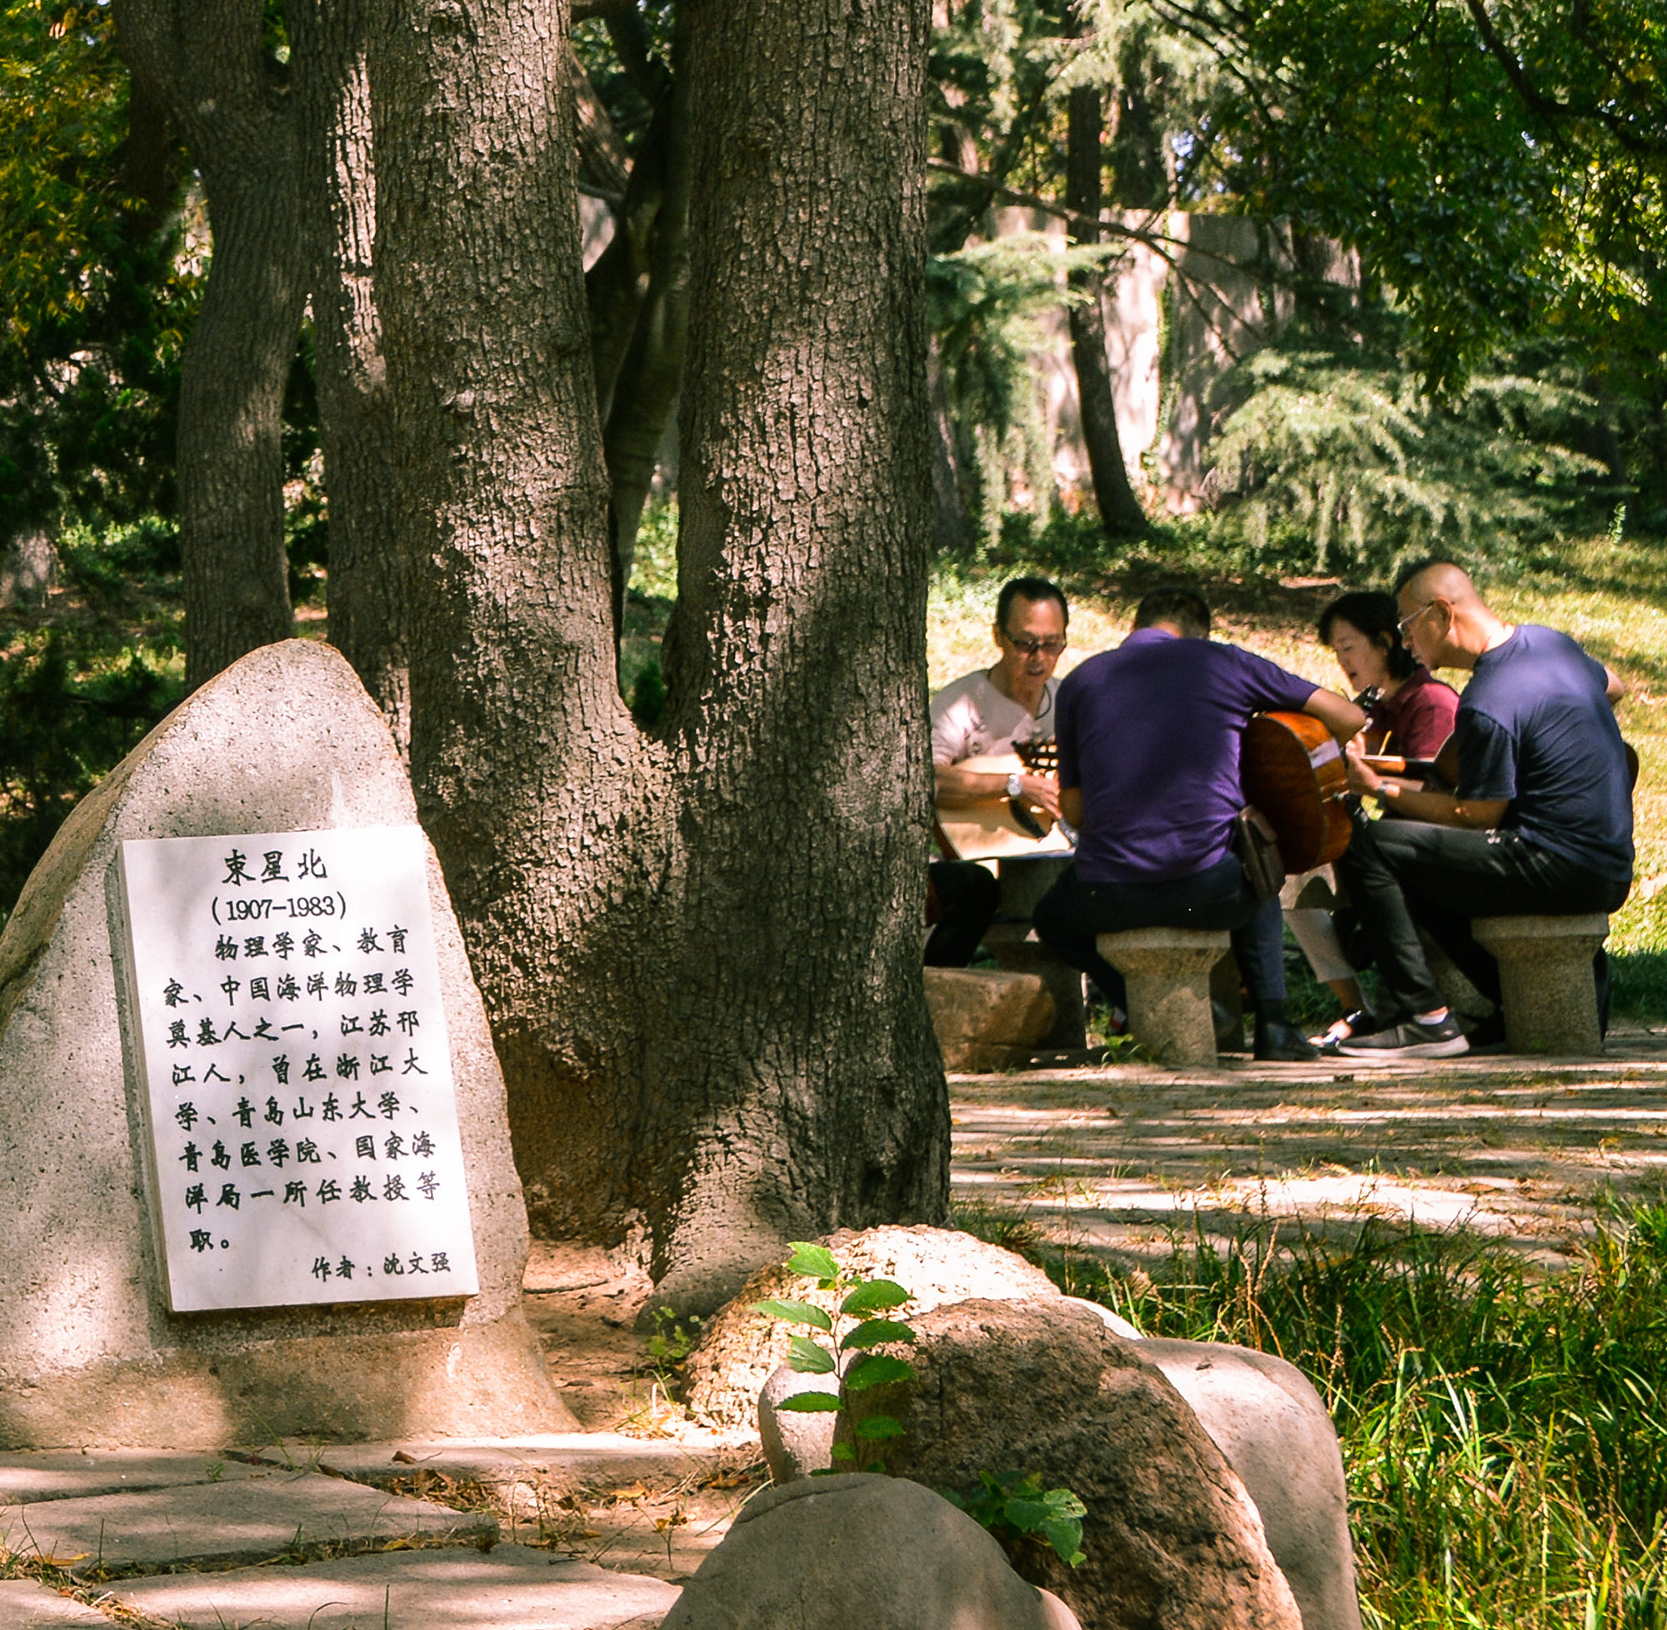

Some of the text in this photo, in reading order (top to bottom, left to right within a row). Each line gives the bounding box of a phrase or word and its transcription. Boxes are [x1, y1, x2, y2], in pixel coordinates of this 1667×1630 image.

[222, 848, 327, 887] 束星北
[211, 891, 346, 925] (1907-1983)
[214, 924, 408, 960] 物理学家、教育
[163, 968, 414, 1008] 家、中国海洋物理学
[172, 1047, 428, 1086] 江人，曾在浙江大
[174, 1090, 419, 1131] 学、青岛山东大学、
[178, 1130, 436, 1172] 青岛医学院、国家海
[185, 1170, 440, 1214] 洋局一所任教授等
[189, 1228, 229, 1252] 职。
